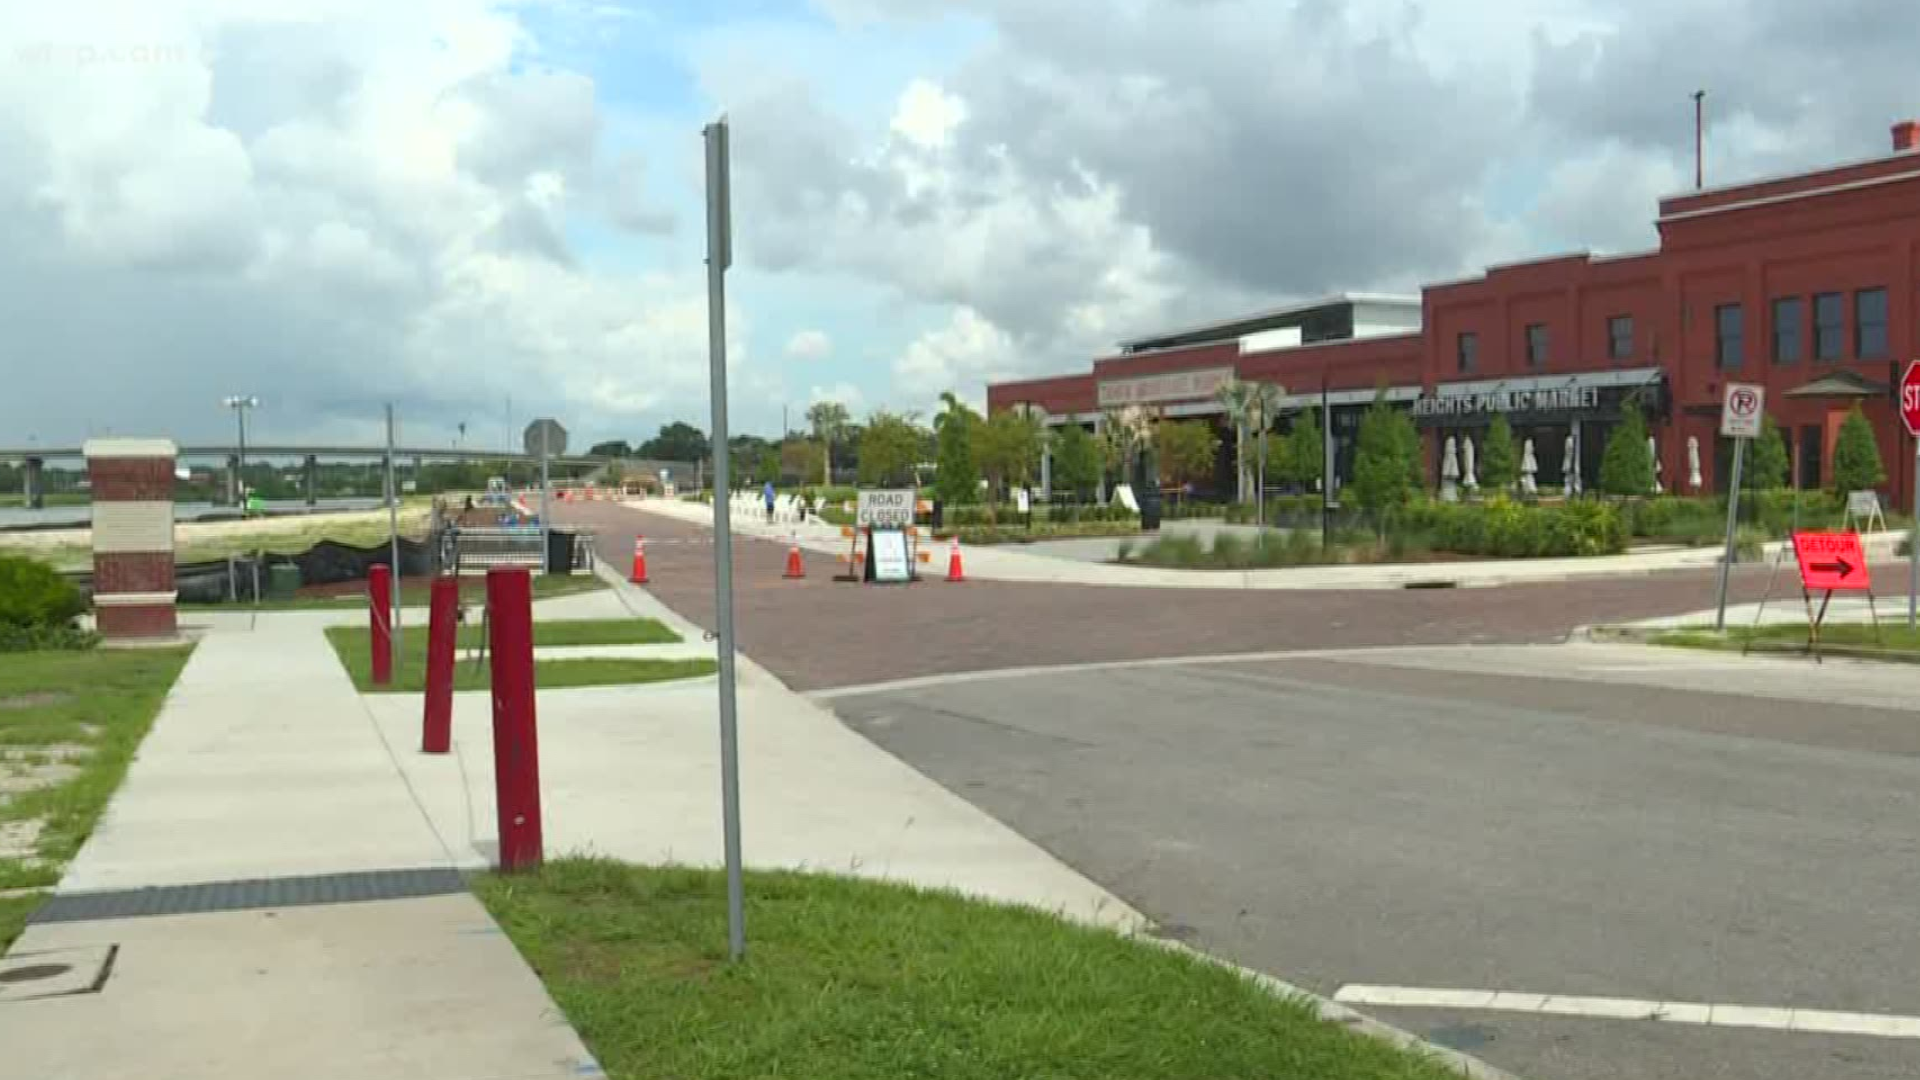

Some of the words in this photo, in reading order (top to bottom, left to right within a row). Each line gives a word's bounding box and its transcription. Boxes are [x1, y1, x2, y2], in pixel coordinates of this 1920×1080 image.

[1413, 397, 1473, 416] HEIGHTS
[1535, 384, 1599, 411] MARKET
[868, 493, 904, 506] ROAD
[861, 508, 909, 523] CLOSED
[1799, 538, 1855, 554] DETOUR
